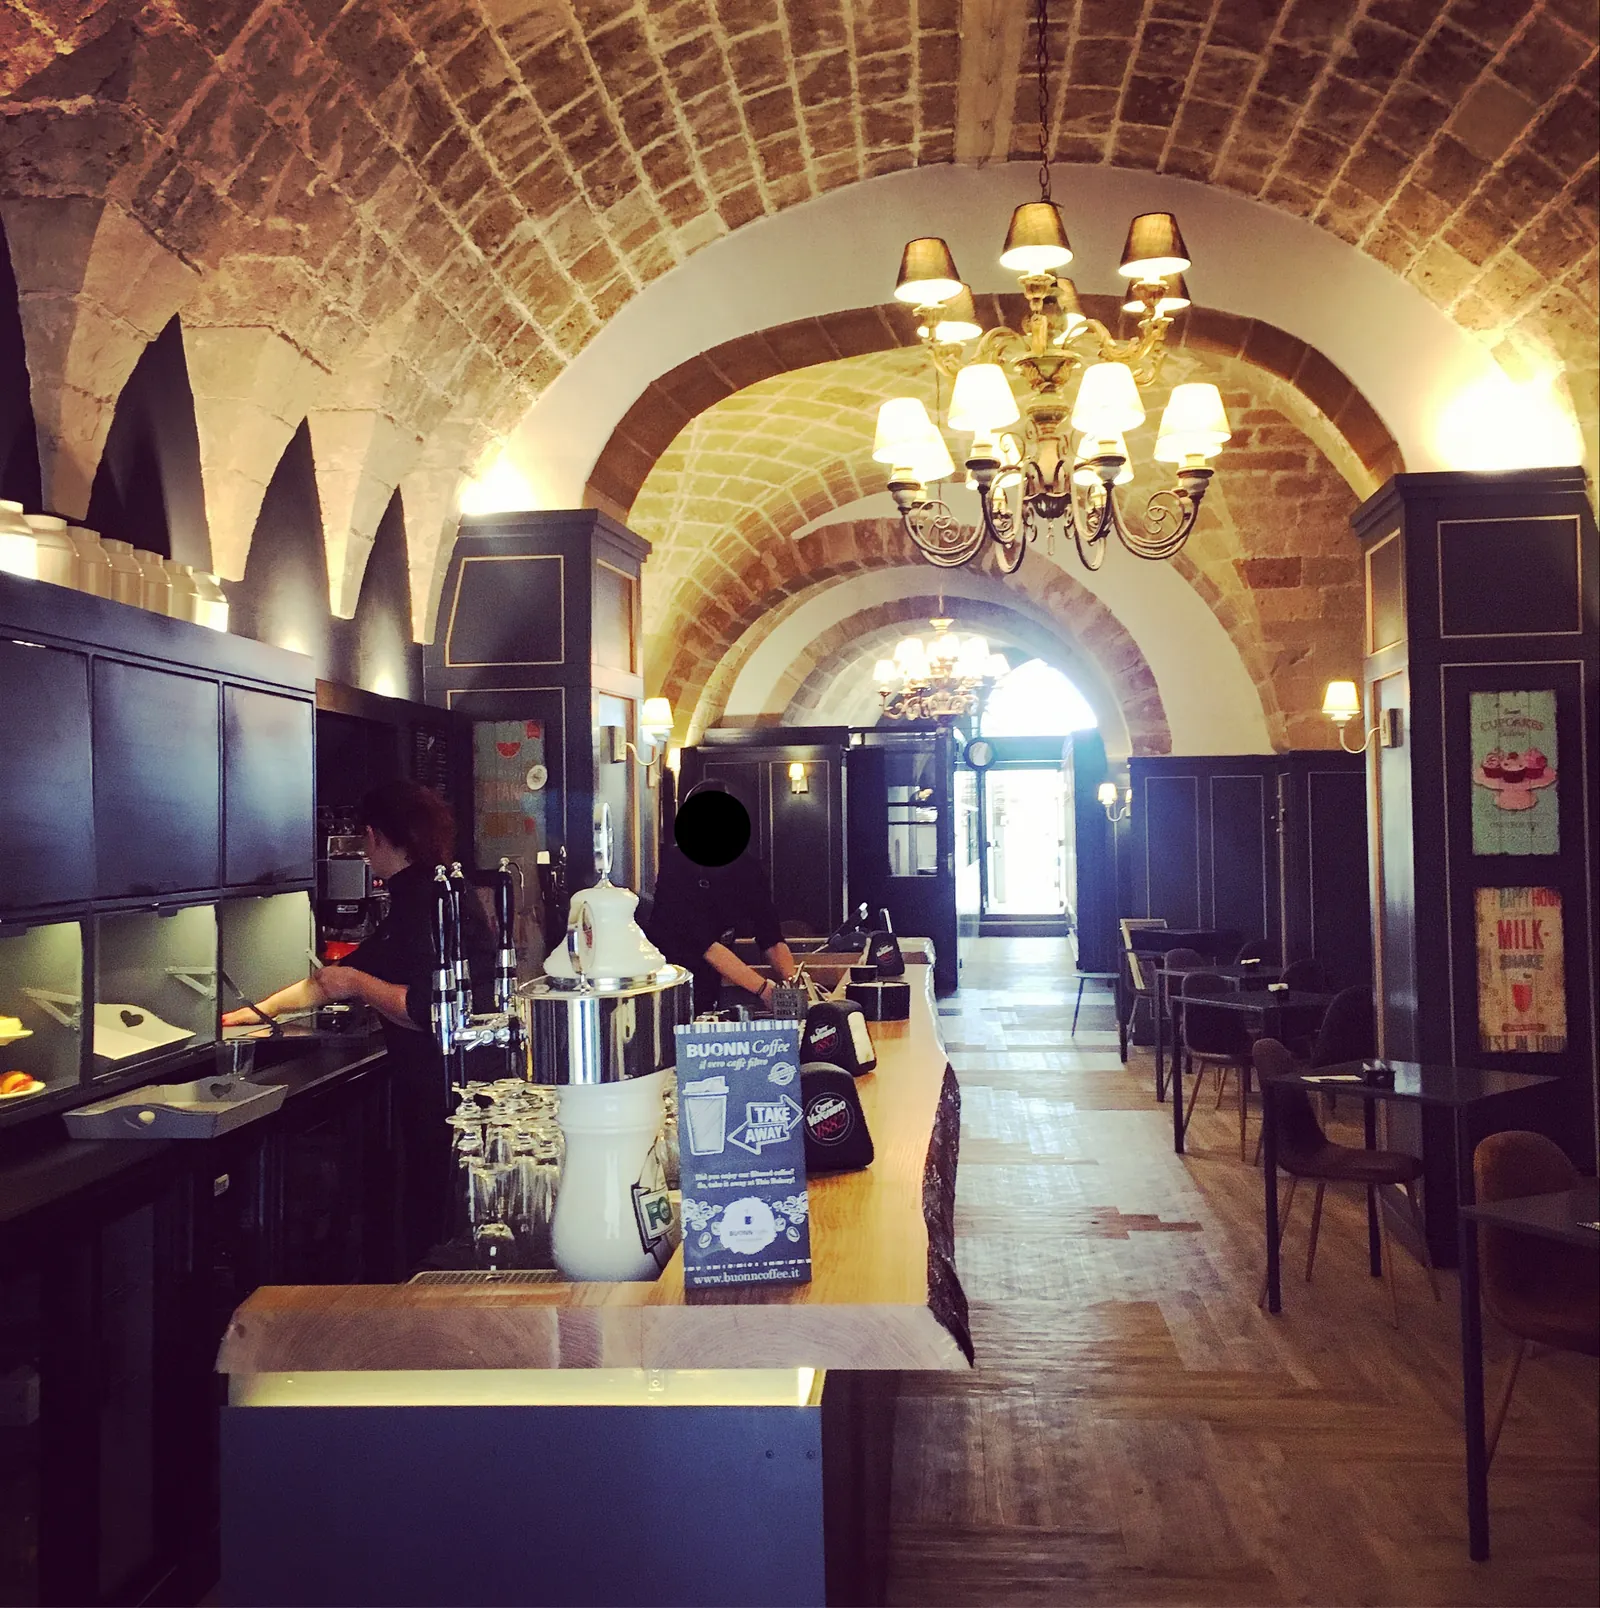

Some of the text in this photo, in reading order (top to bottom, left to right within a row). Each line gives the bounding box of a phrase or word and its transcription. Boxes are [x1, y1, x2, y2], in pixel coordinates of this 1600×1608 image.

[1497, 919, 1544, 949] MILK
[1500, 954, 1544, 971] SHAKE
[686, 1038, 790, 1058] BUONN Coffee
[754, 1107, 791, 1123] TAKE
[745, 1126, 782, 1143] AWAY
[694, 1268, 800, 1284] www.buonncoffee.it
